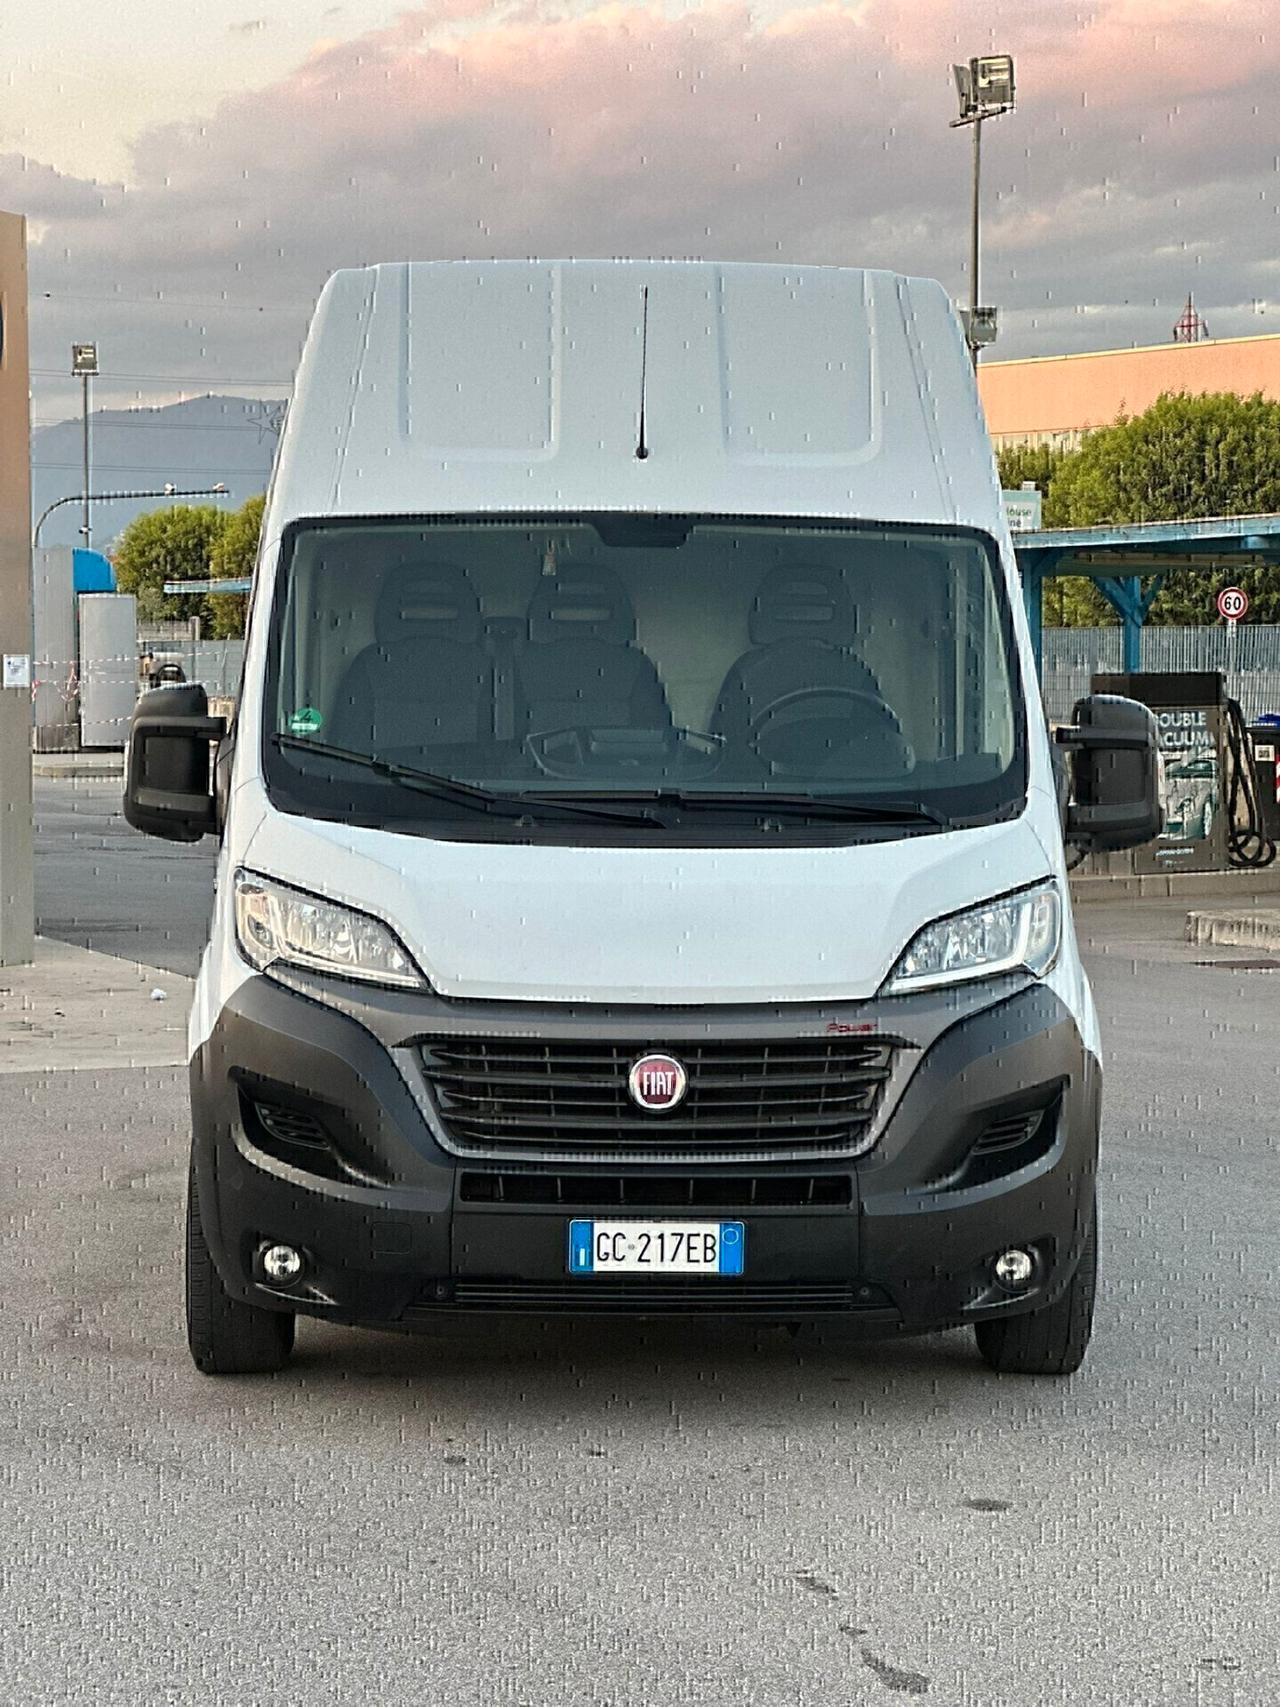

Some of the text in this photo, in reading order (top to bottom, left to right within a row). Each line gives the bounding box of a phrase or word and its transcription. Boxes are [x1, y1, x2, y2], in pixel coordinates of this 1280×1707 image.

[1224, 596, 1242, 610] 60
[301, 710, 314, 722] 4
[1158, 731, 1209, 746] CUUM
[643, 1071, 674, 1096] FIAT
[637, 1232, 717, 1263] 217EB
